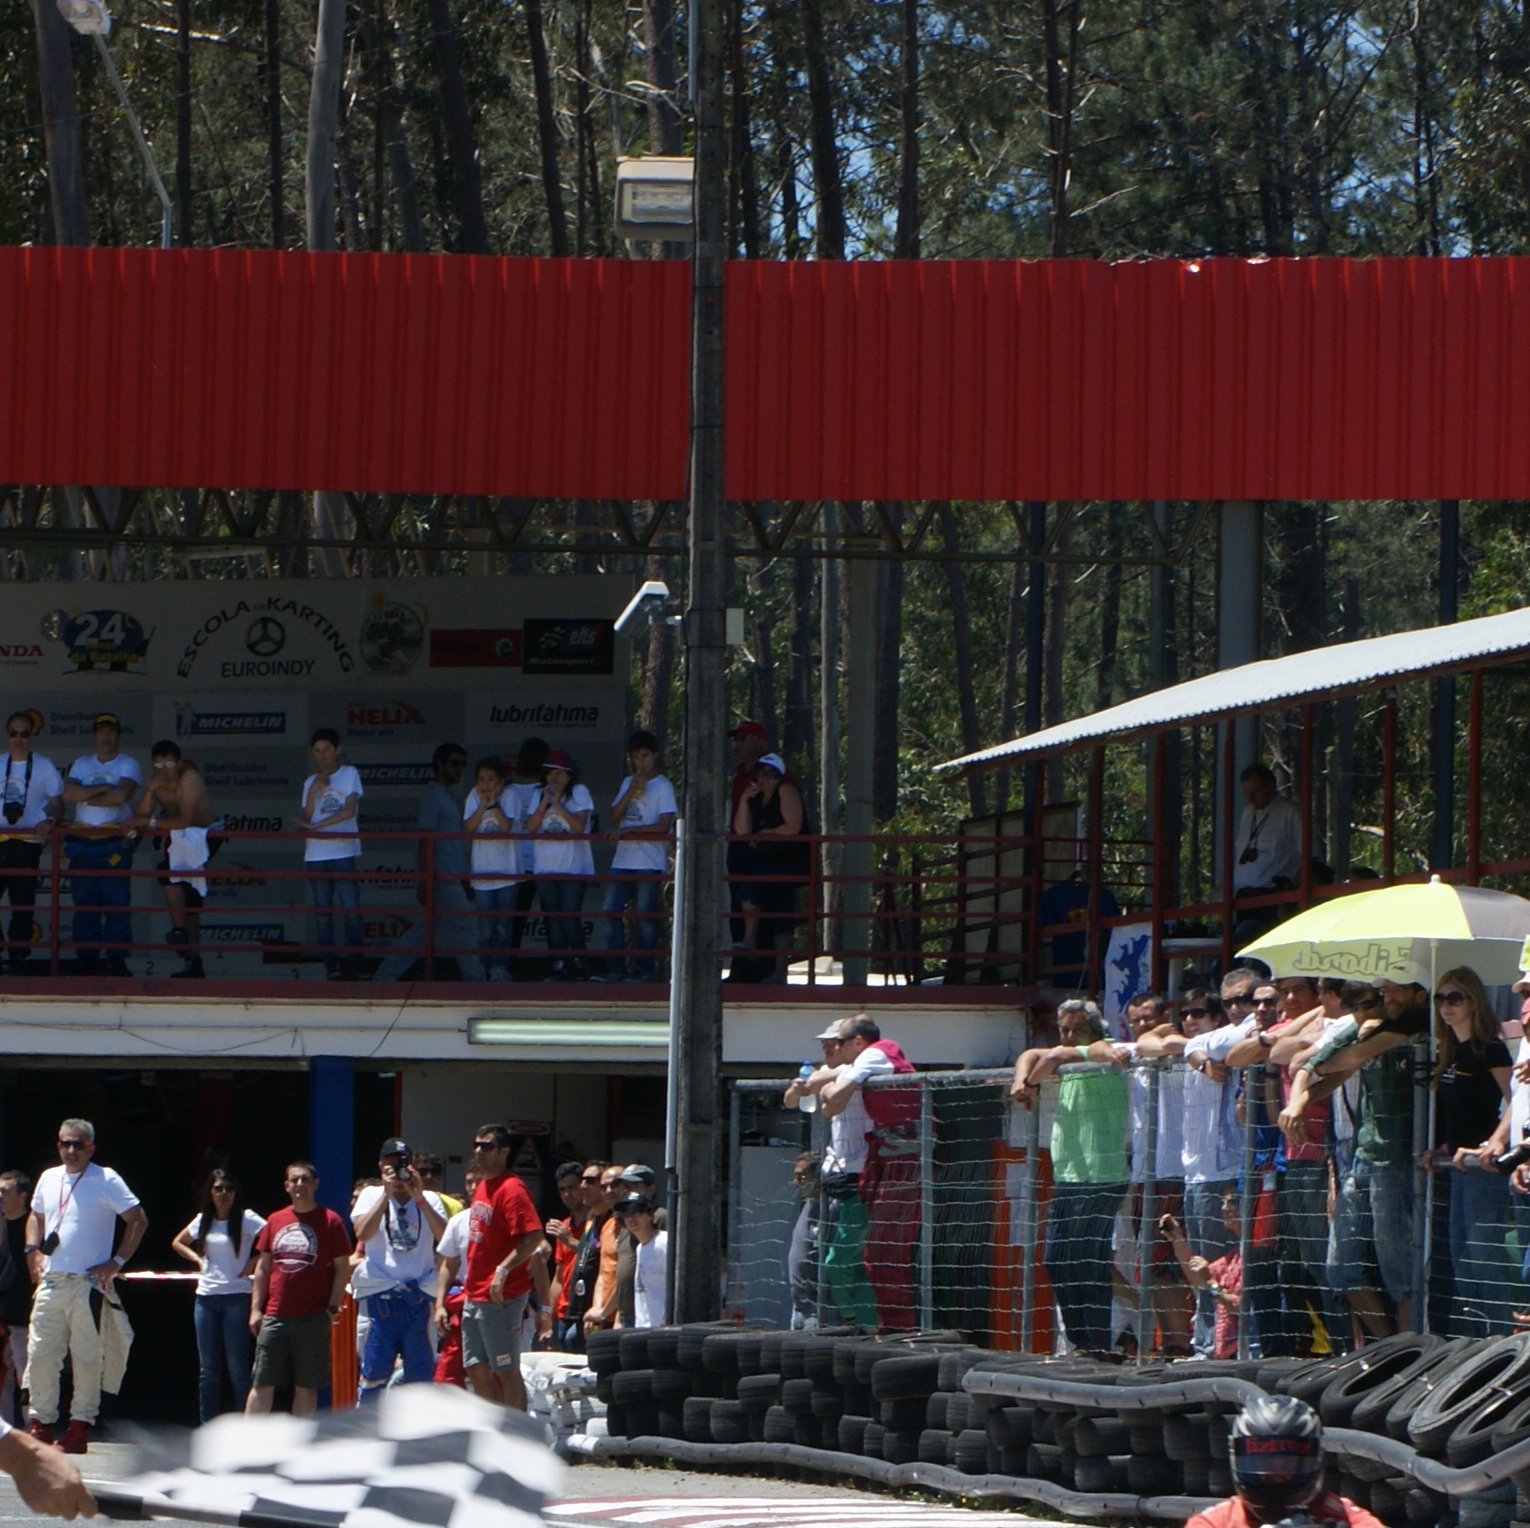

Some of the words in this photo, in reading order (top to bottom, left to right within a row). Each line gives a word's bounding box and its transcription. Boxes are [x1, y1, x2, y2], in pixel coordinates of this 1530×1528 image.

[73, 612, 126, 647] 24
[177, 601, 250, 678] ESCOLA
[267, 597, 354, 673] KARTING
[221, 660, 316, 678] EUROINDY
[197, 715, 282, 730] MICHELIN
[347, 707, 426, 726] HELIX
[489, 704, 599, 724] lubrifatima
